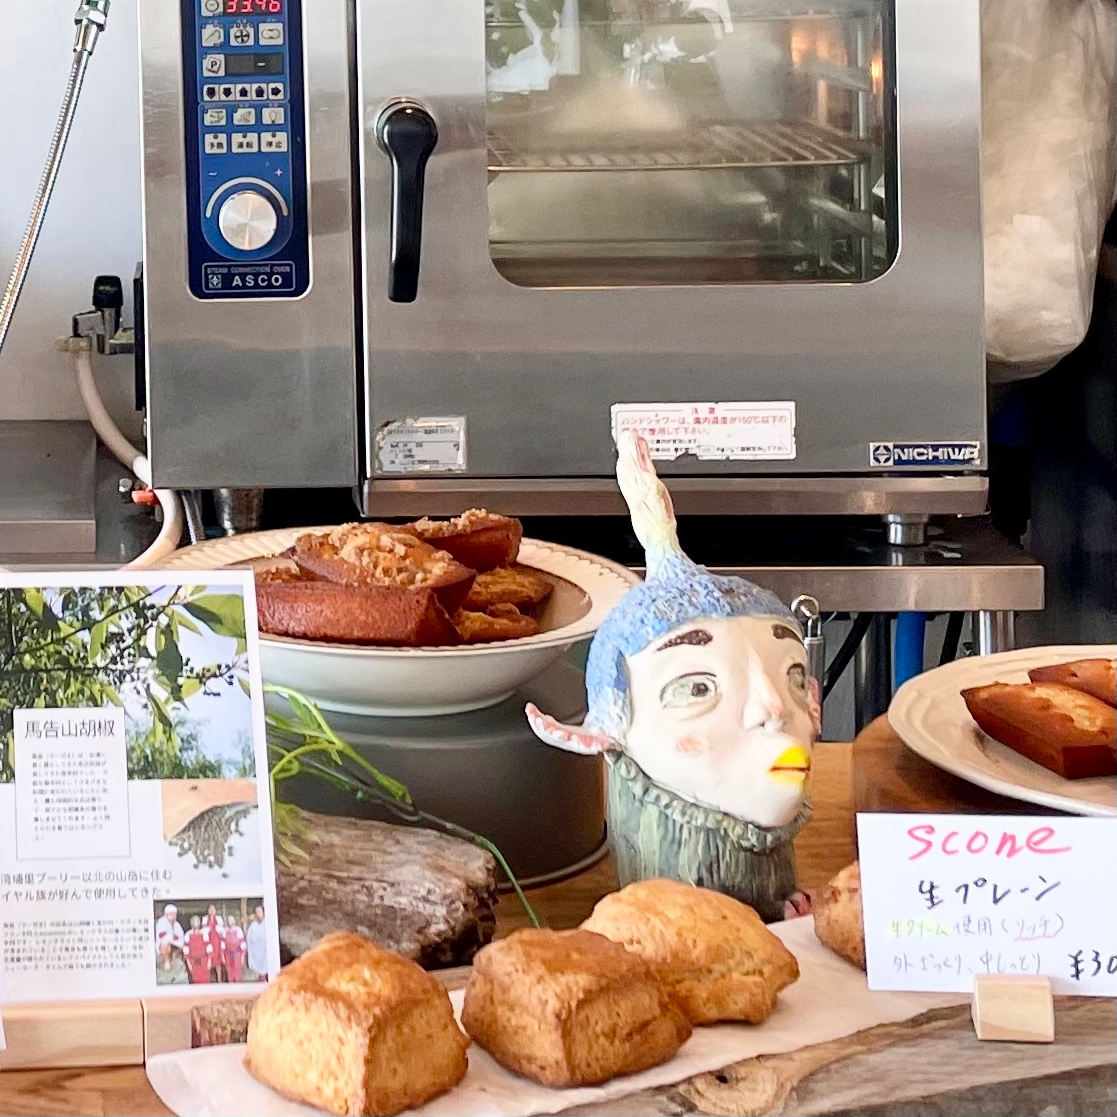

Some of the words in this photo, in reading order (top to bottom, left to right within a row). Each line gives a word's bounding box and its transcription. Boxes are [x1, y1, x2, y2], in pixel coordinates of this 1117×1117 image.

[231, 275, 283, 287] ASCO
[24, 719, 116, 739] 馬告山胡椒
